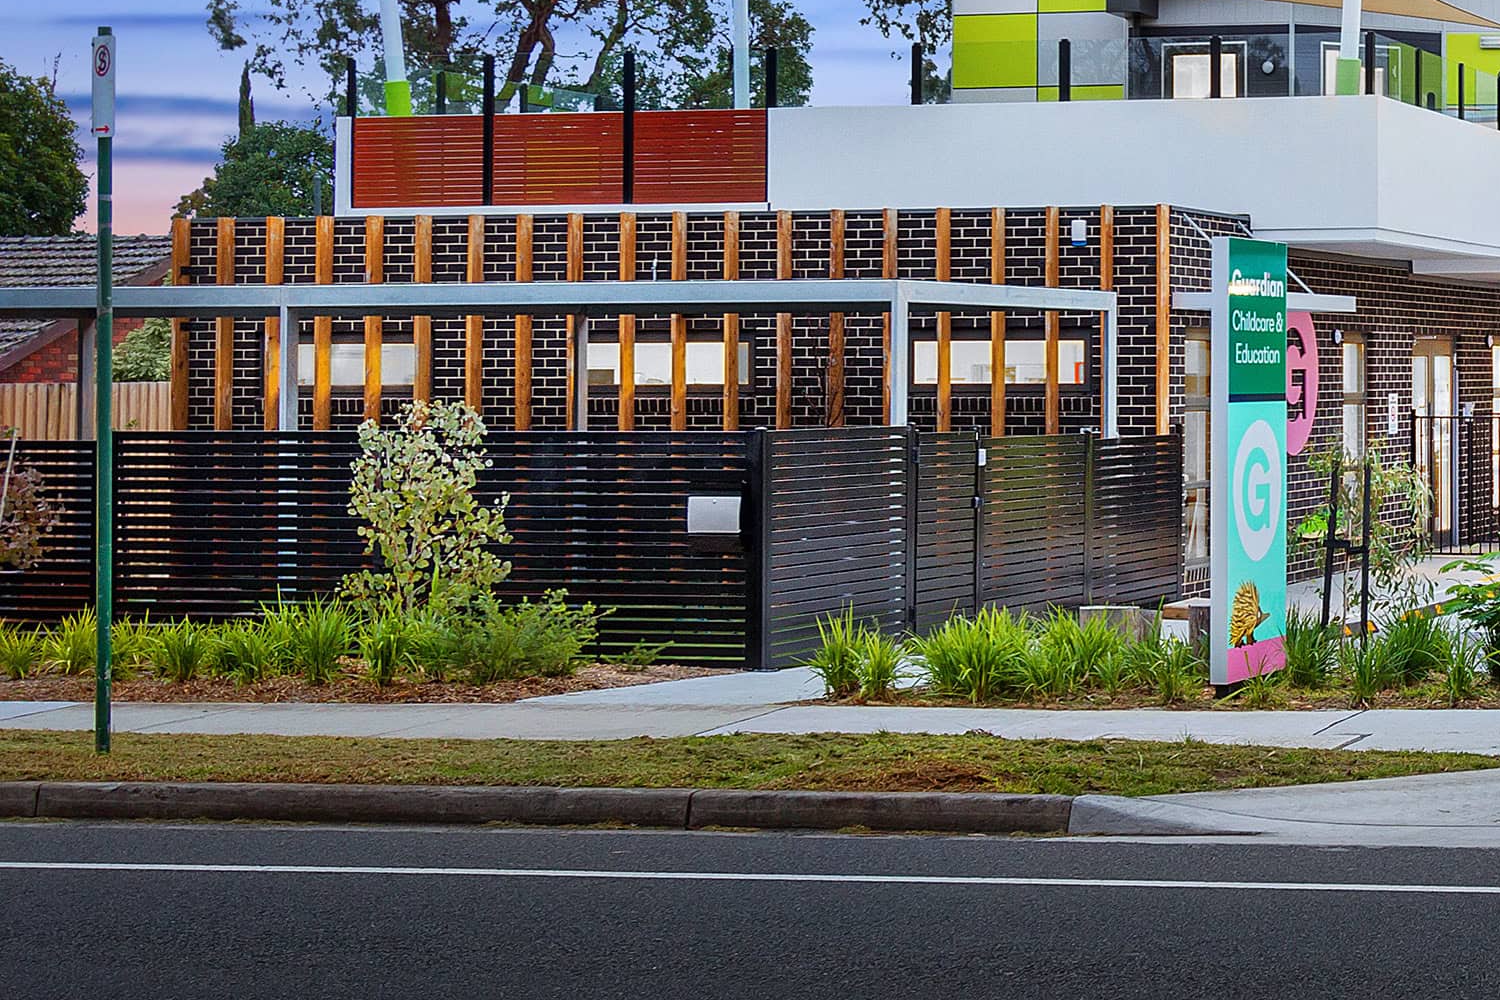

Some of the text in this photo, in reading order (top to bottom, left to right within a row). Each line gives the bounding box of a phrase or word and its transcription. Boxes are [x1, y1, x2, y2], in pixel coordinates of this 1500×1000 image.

[1231, 268, 1284, 297] Guardian
[1232, 310, 1283, 333] Childcare &
[1235, 342, 1280, 364] Education
[1242, 447, 1270, 532] G
